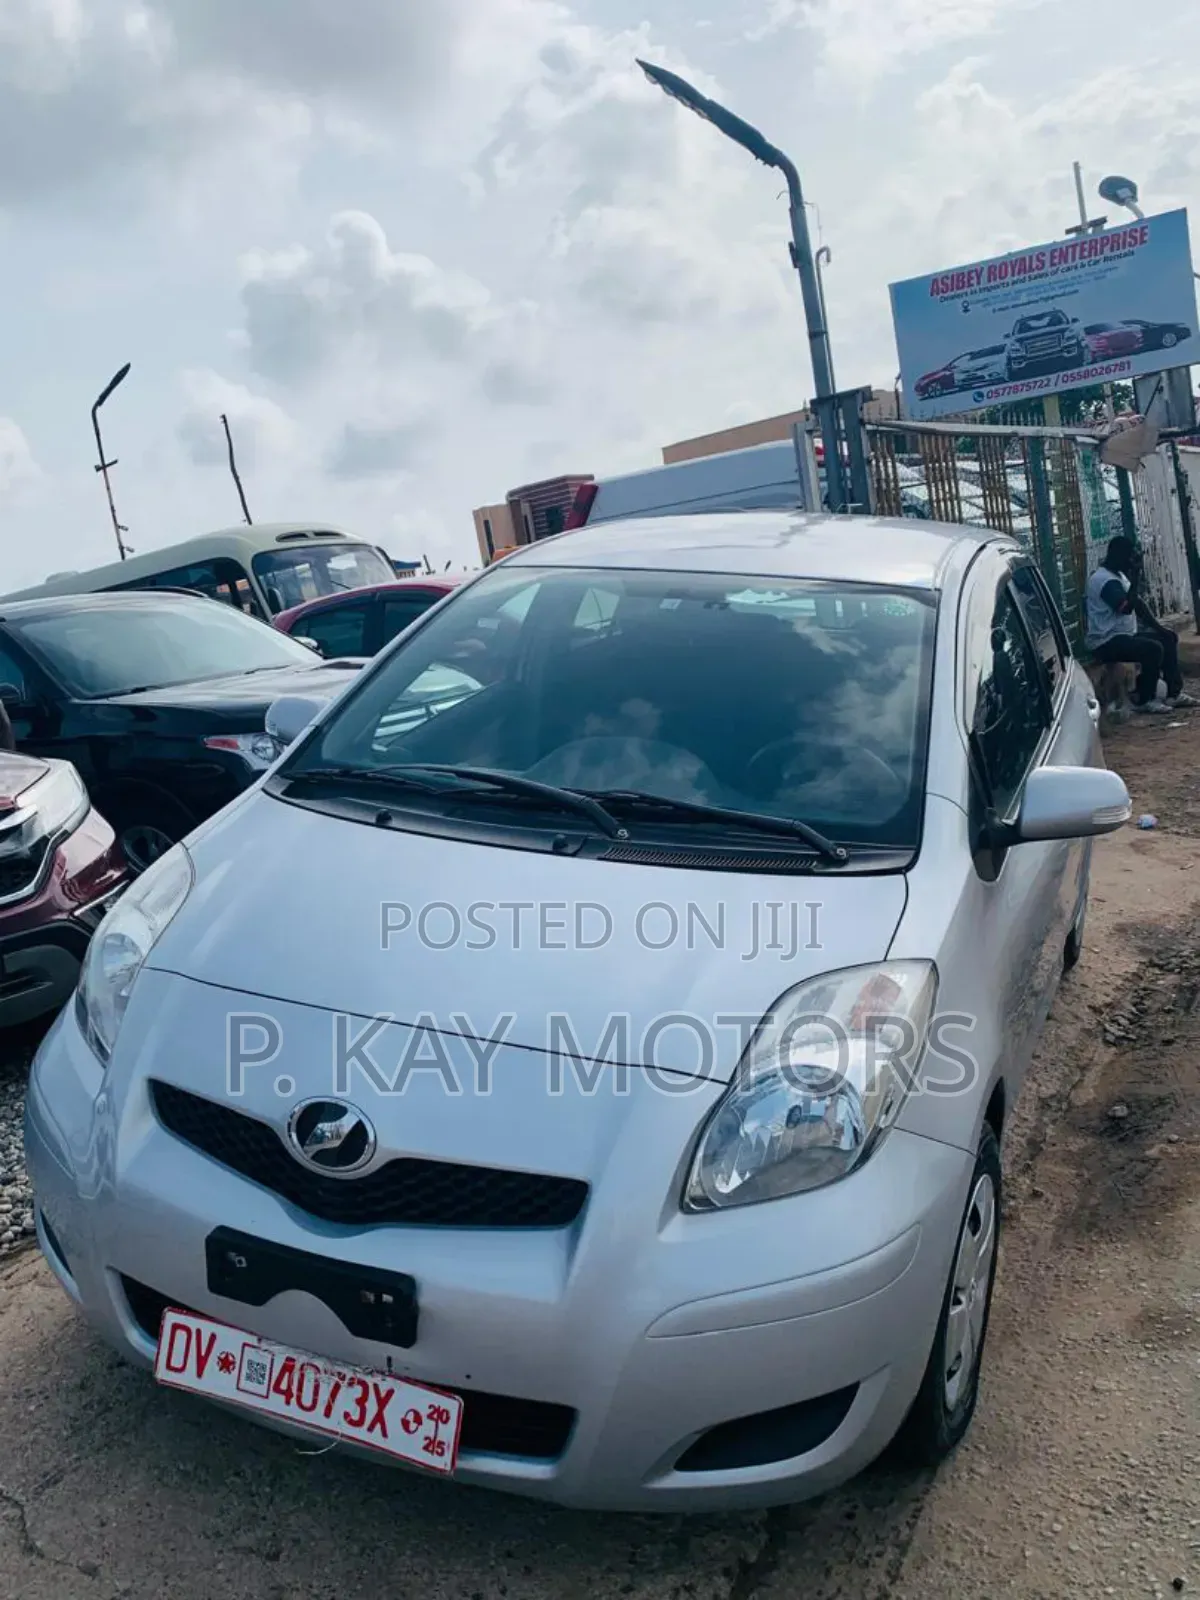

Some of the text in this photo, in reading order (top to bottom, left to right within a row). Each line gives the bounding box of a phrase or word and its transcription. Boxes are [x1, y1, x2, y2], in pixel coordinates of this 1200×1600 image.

[930, 266, 985, 296] ASIBEY
[987, 251, 1047, 283] ROYALS
[1050, 225, 1149, 267] ENTERPRISE
[979, 280, 1010, 295] Imports
[1011, 275, 1027, 287] and
[1028, 271, 1050, 283] Sales
[1050, 267, 1060, 277] of
[1061, 263, 1078, 274] cars
[1079, 261, 1087, 270] &
[1087, 257, 1102, 268] Car
[1103, 248, 1136, 263] Rentals
[986, 377, 1050, 400] 0577875722
[1061, 360, 1132, 384] 0558026781
[165, 1322, 396, 1439] DV 4073X
